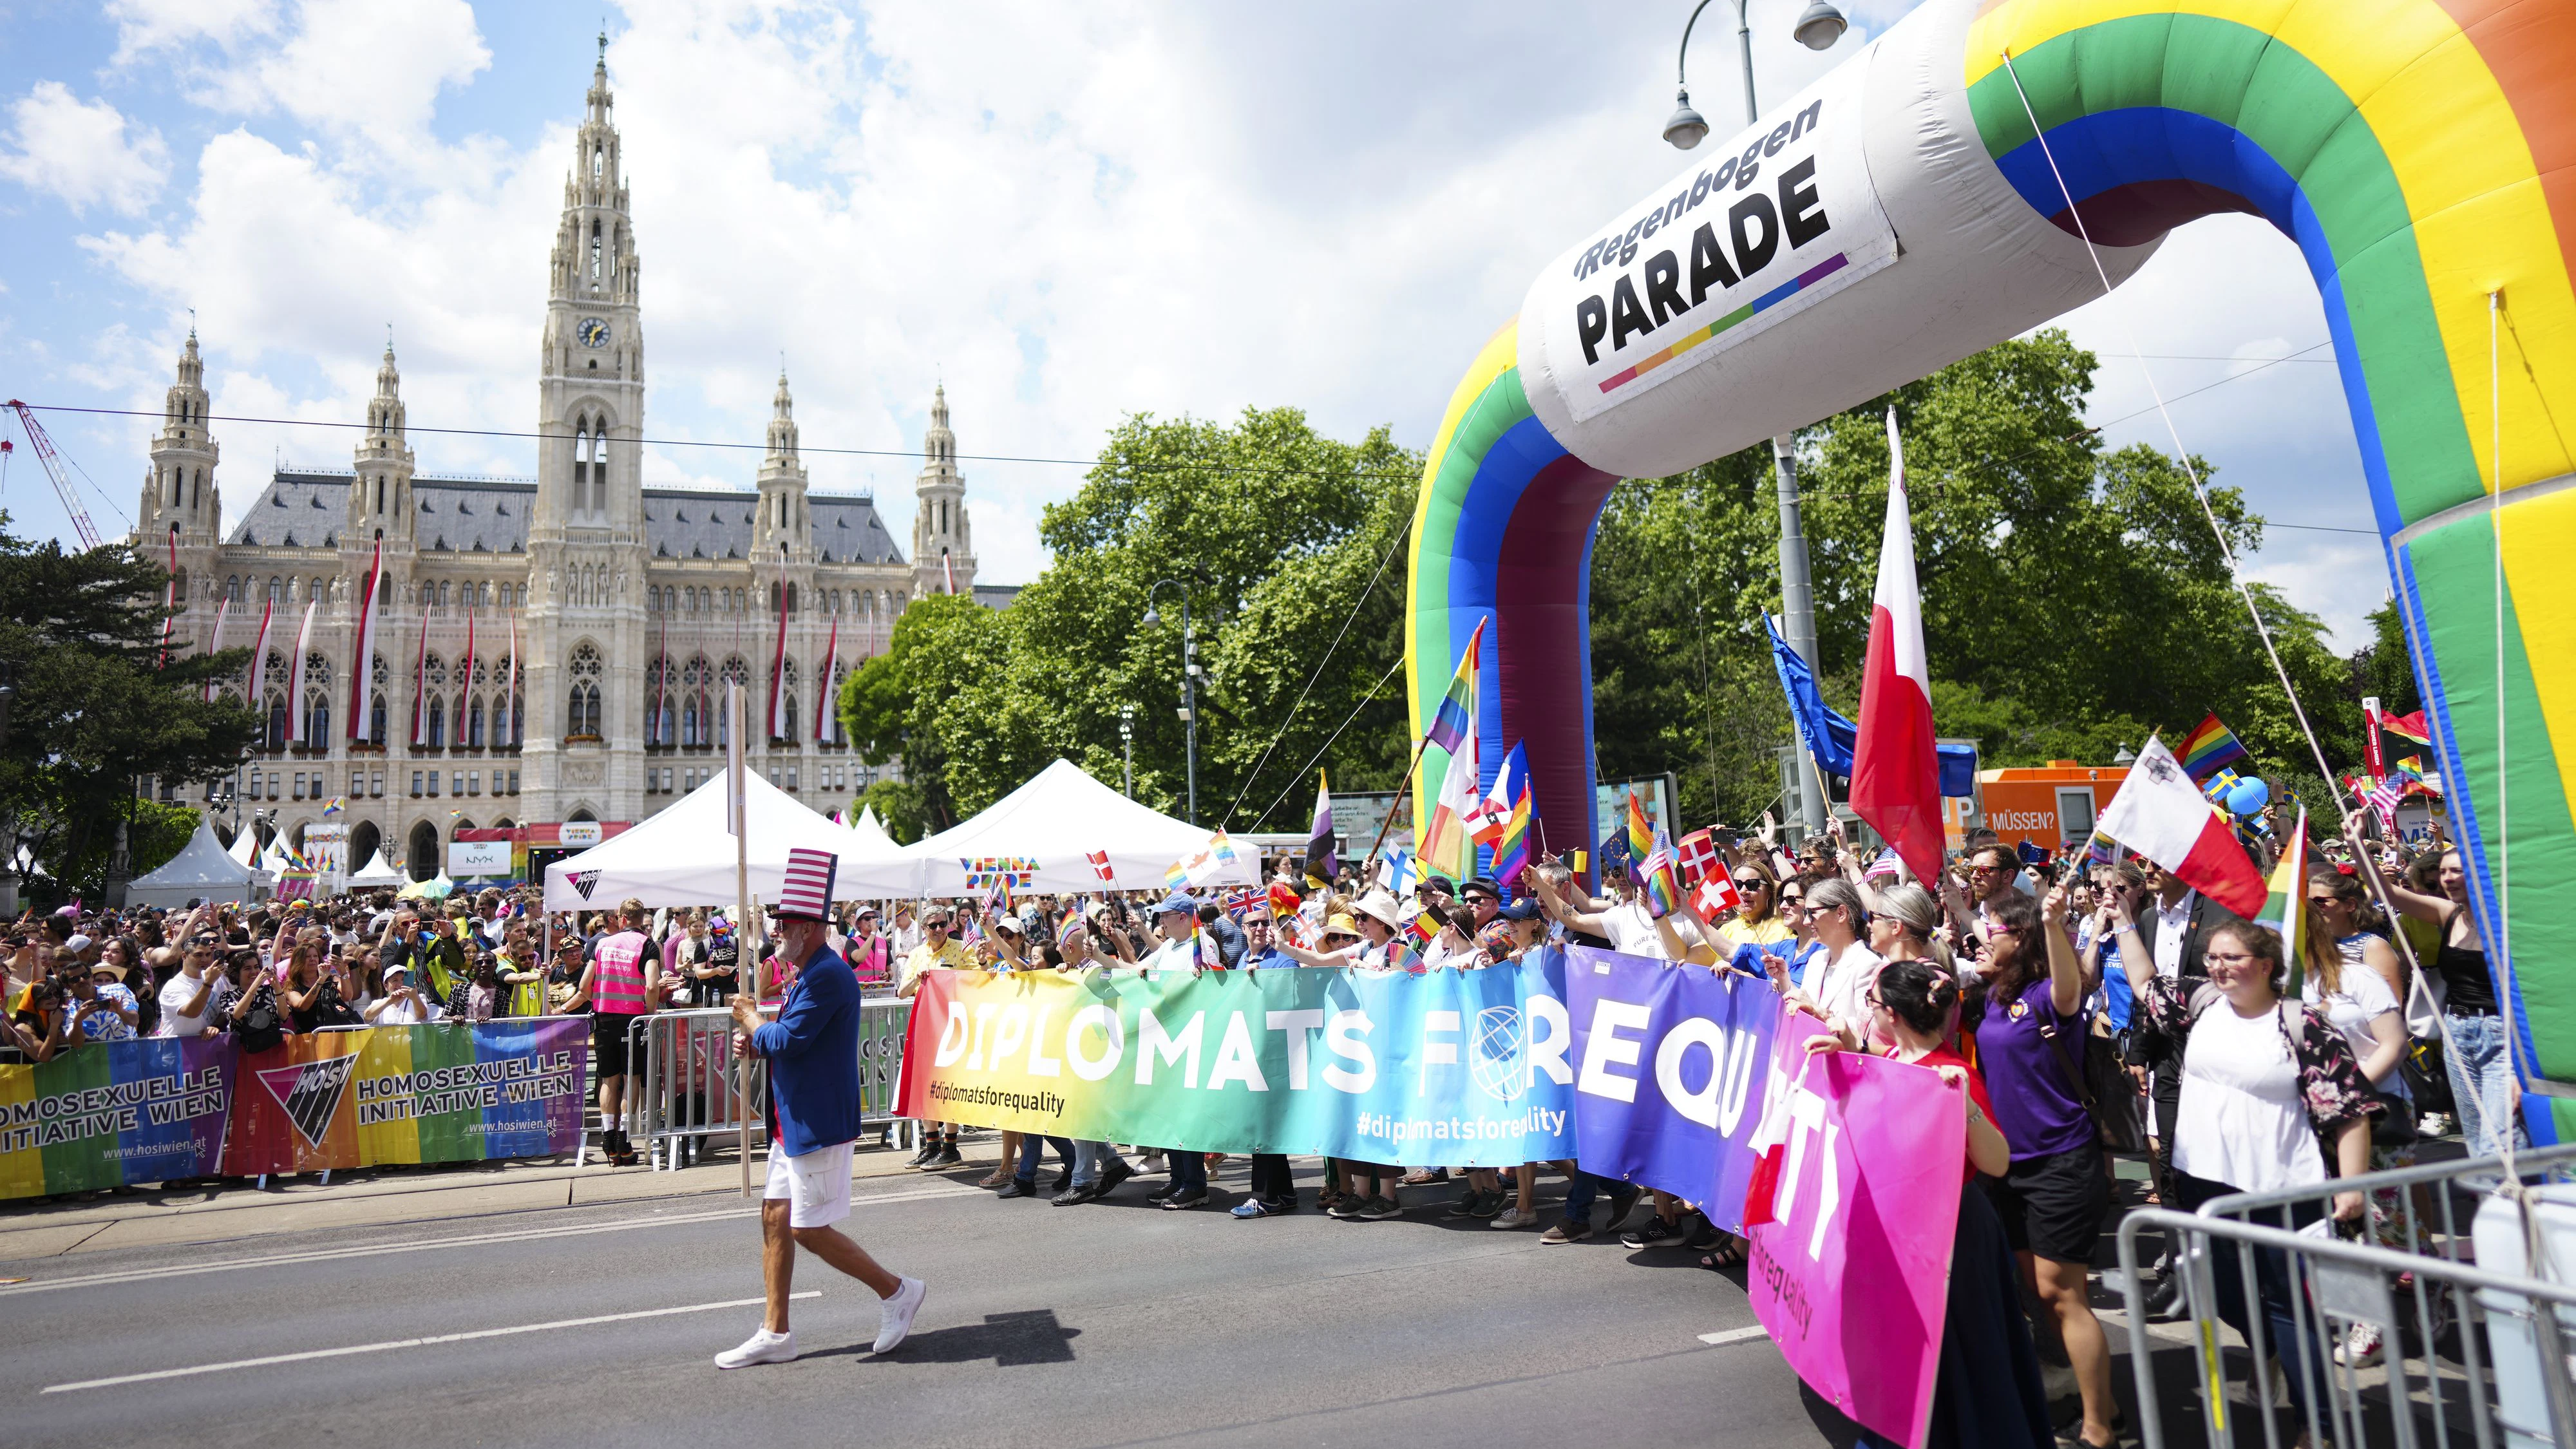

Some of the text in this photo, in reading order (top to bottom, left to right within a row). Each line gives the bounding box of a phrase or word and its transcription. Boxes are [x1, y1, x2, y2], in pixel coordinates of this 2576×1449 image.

[1573, 99, 1823, 282] Regenbogen
[1577, 155, 1831, 366] PARADE
[1992, 809, 2055, 831] MÜSSEN?
[466, 855, 493, 864] NYX
[577, 869, 602, 883] HOSI
[959, 857, 1041, 872] VIENNA
[1633, 935, 1649, 948] PURE
[934, 999, 1377, 1094] DIPLOMATS
[293, 1062, 354, 1095] HOSI
[356, 1050, 572, 1102] HOMOSEXUELLE
[358, 1073, 574, 1126] INITIATIVE WIEN
[929, 1079, 1065, 1118] #diplomatsforequality
[0, 1089, 225, 1154] ITIATIVE WIEN
[469, 1117, 557, 1133] www.hosiwien.at
[103, 1136, 207, 1160] www.hosiwien.at
